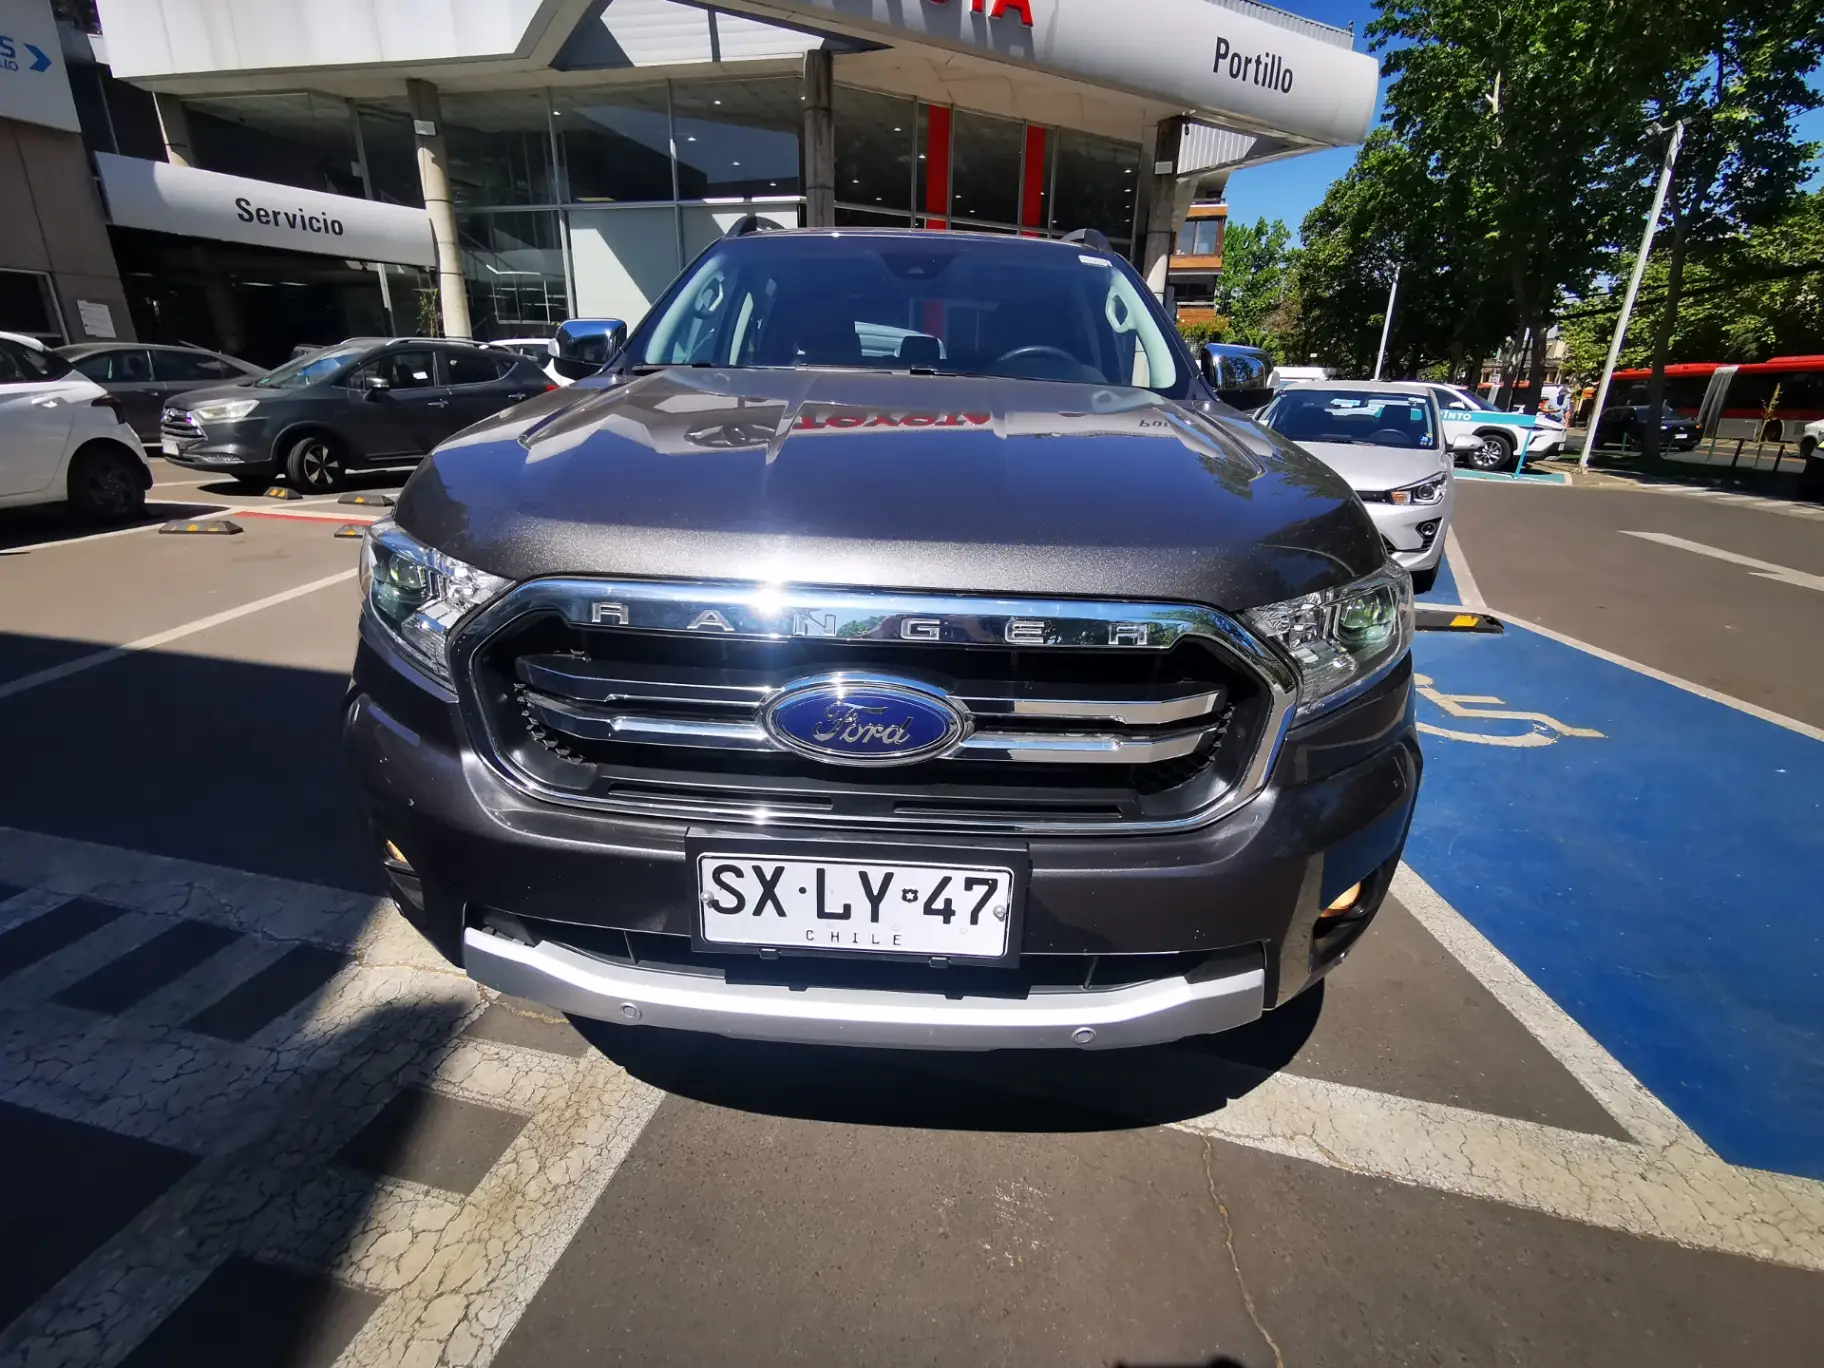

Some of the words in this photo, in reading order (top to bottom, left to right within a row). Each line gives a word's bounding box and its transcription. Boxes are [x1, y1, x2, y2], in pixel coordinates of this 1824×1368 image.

[1212, 36, 1294, 94] Portillo
[235, 197, 344, 236] Servicio
[1440, 410, 1472, 421] INTO
[591, 601, 1148, 646] RANGER
[812, 701, 914, 745] Ford
[805, 929, 902, 946] CHILE
